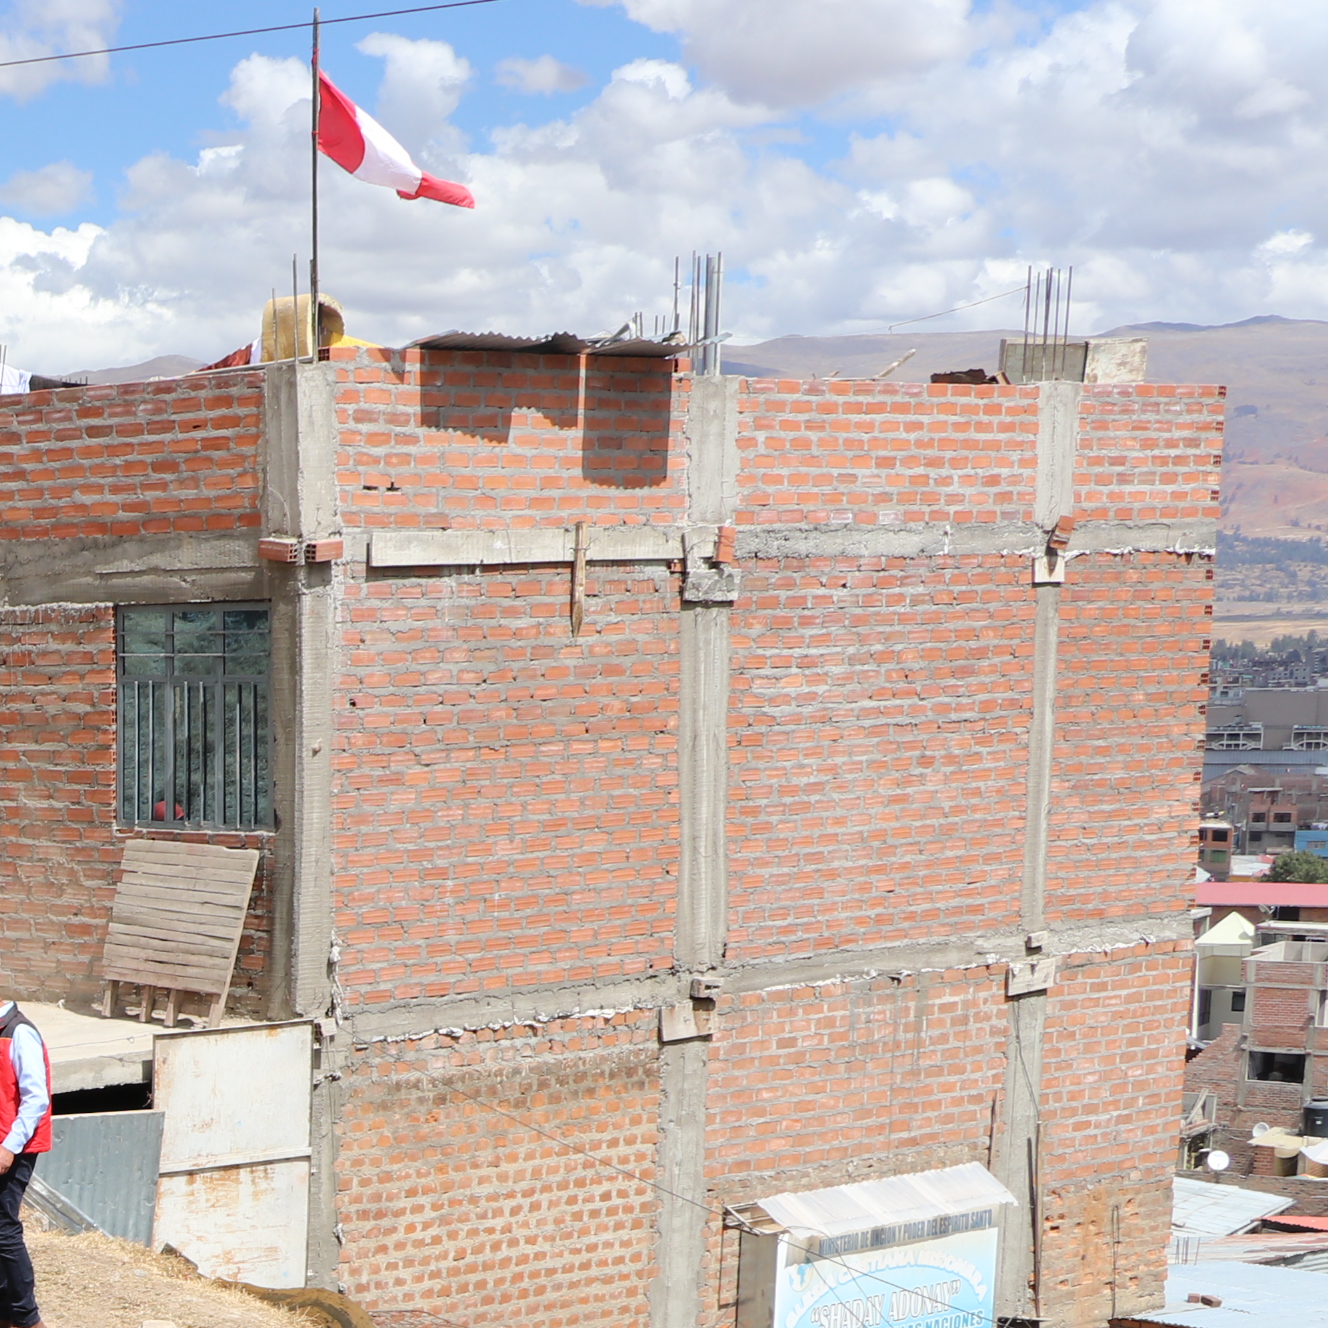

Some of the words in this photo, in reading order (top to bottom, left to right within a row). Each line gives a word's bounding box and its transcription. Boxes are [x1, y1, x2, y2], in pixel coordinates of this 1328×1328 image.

[819, 1232, 859, 1255] MINISTERIO
[860, 1229, 870, 1248] DE
[904, 1220, 926, 1241] PODER
[926, 1218, 939, 1237] DEL
[939, 1212, 970, 1235] ESPIRITU
[971, 1208, 992, 1229] SANTO
